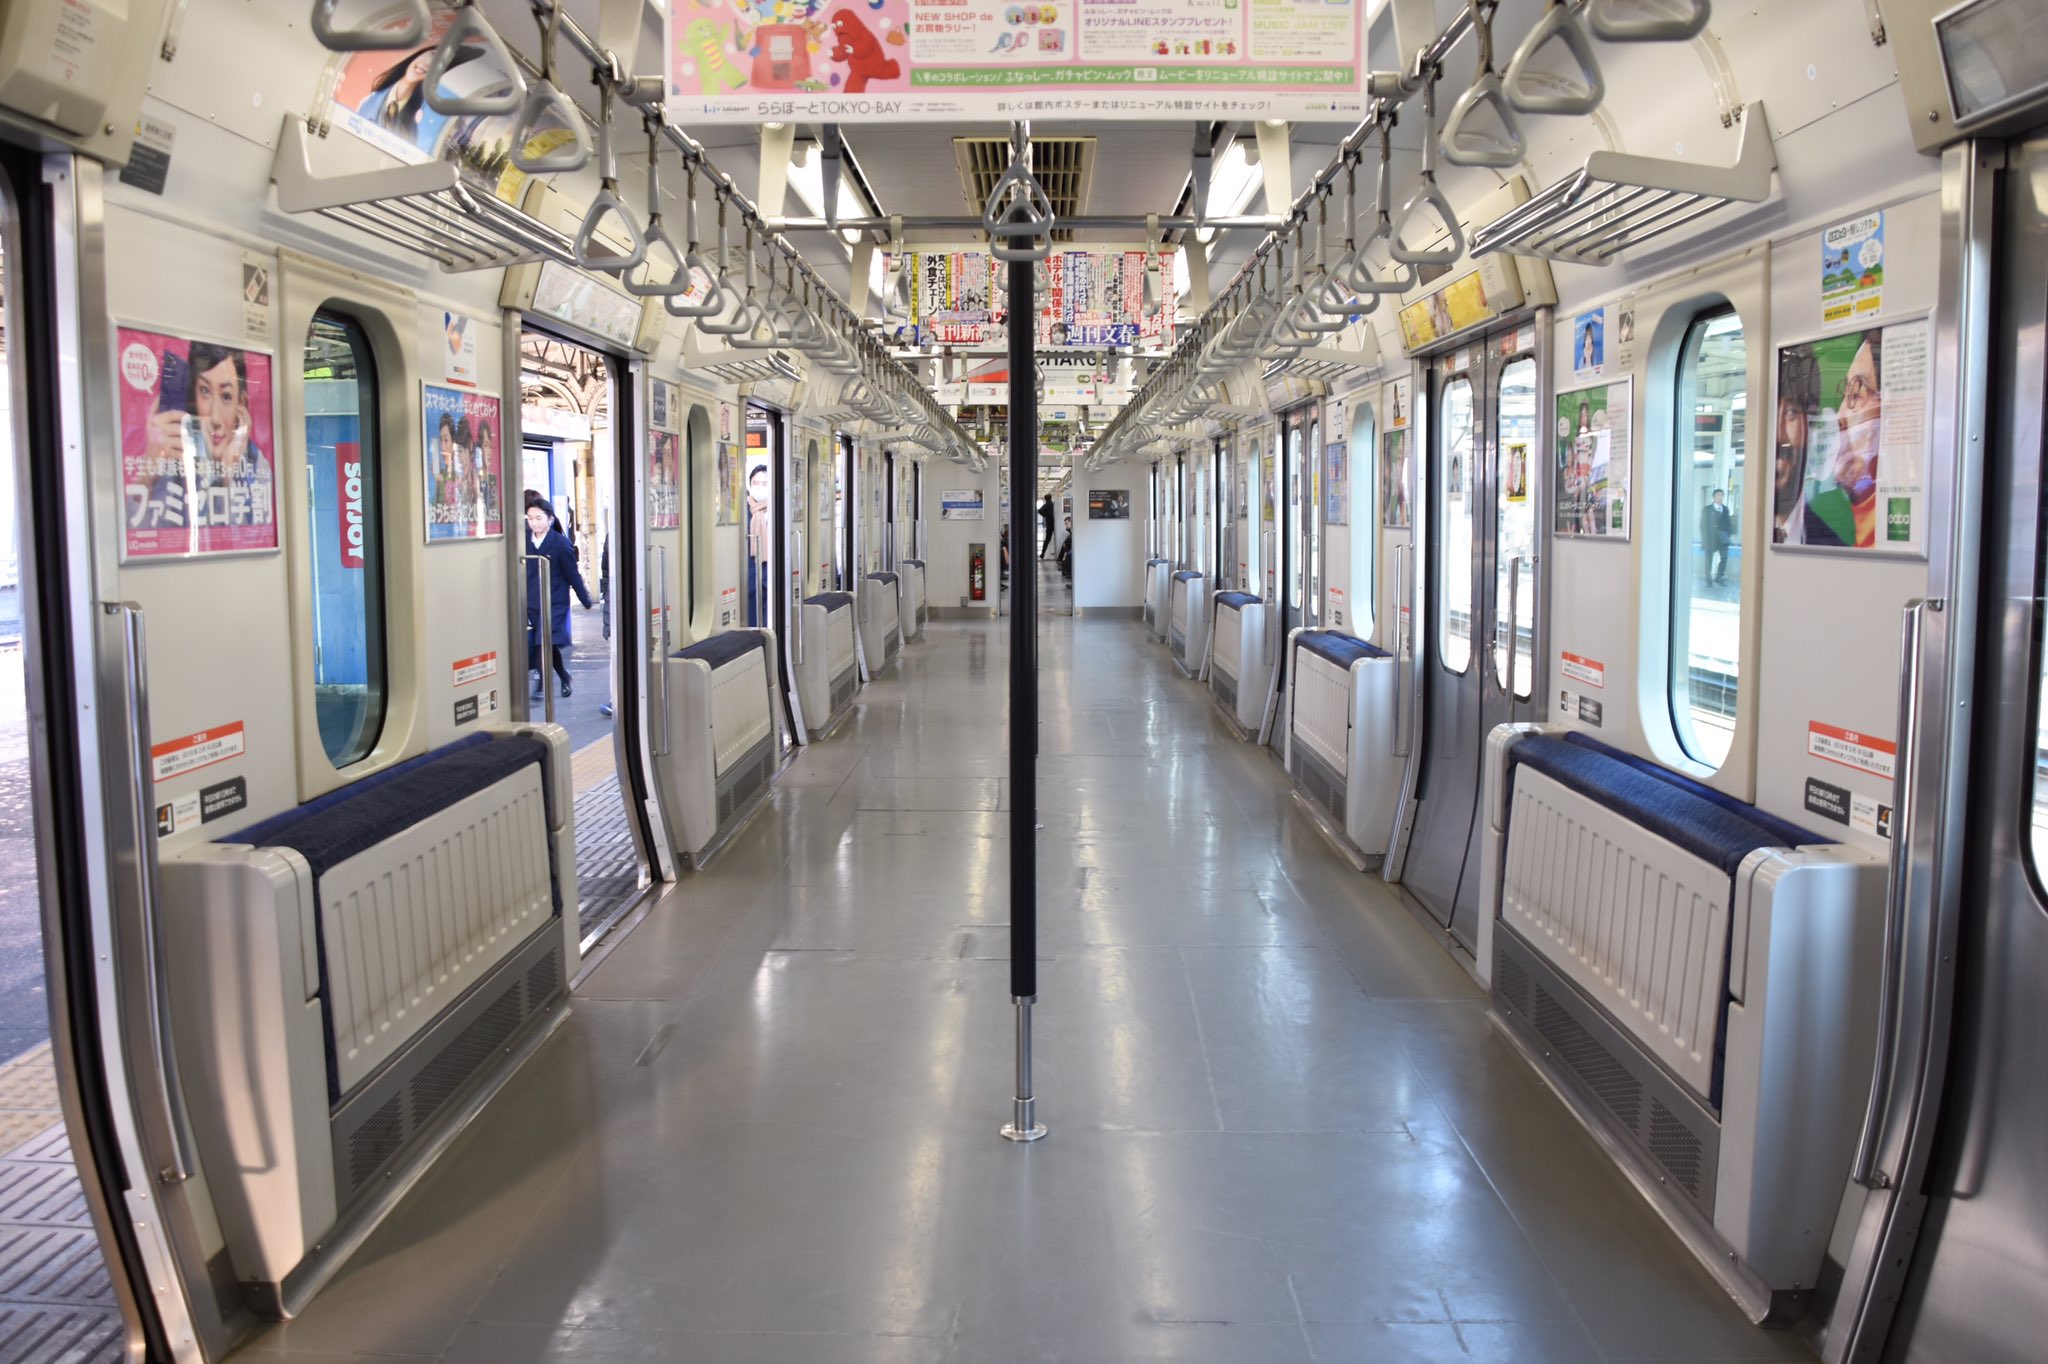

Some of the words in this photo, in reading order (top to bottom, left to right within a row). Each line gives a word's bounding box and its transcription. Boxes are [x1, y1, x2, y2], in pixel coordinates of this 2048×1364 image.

[915, 12, 941, 21] NEW
[945, 12, 977, 21] SHOP
[980, 12, 994, 21] de
[915, 23, 976, 33] お買物ラリー！
[927, 254, 938, 316] 外食チェーン
[938, 254, 946, 312] 食べてはいけない
[1067, 324, 1136, 344] 週刊文春
[126, 478, 273, 528] ファミゼロ学割
[344, 461, 364, 560] SOYJOY
